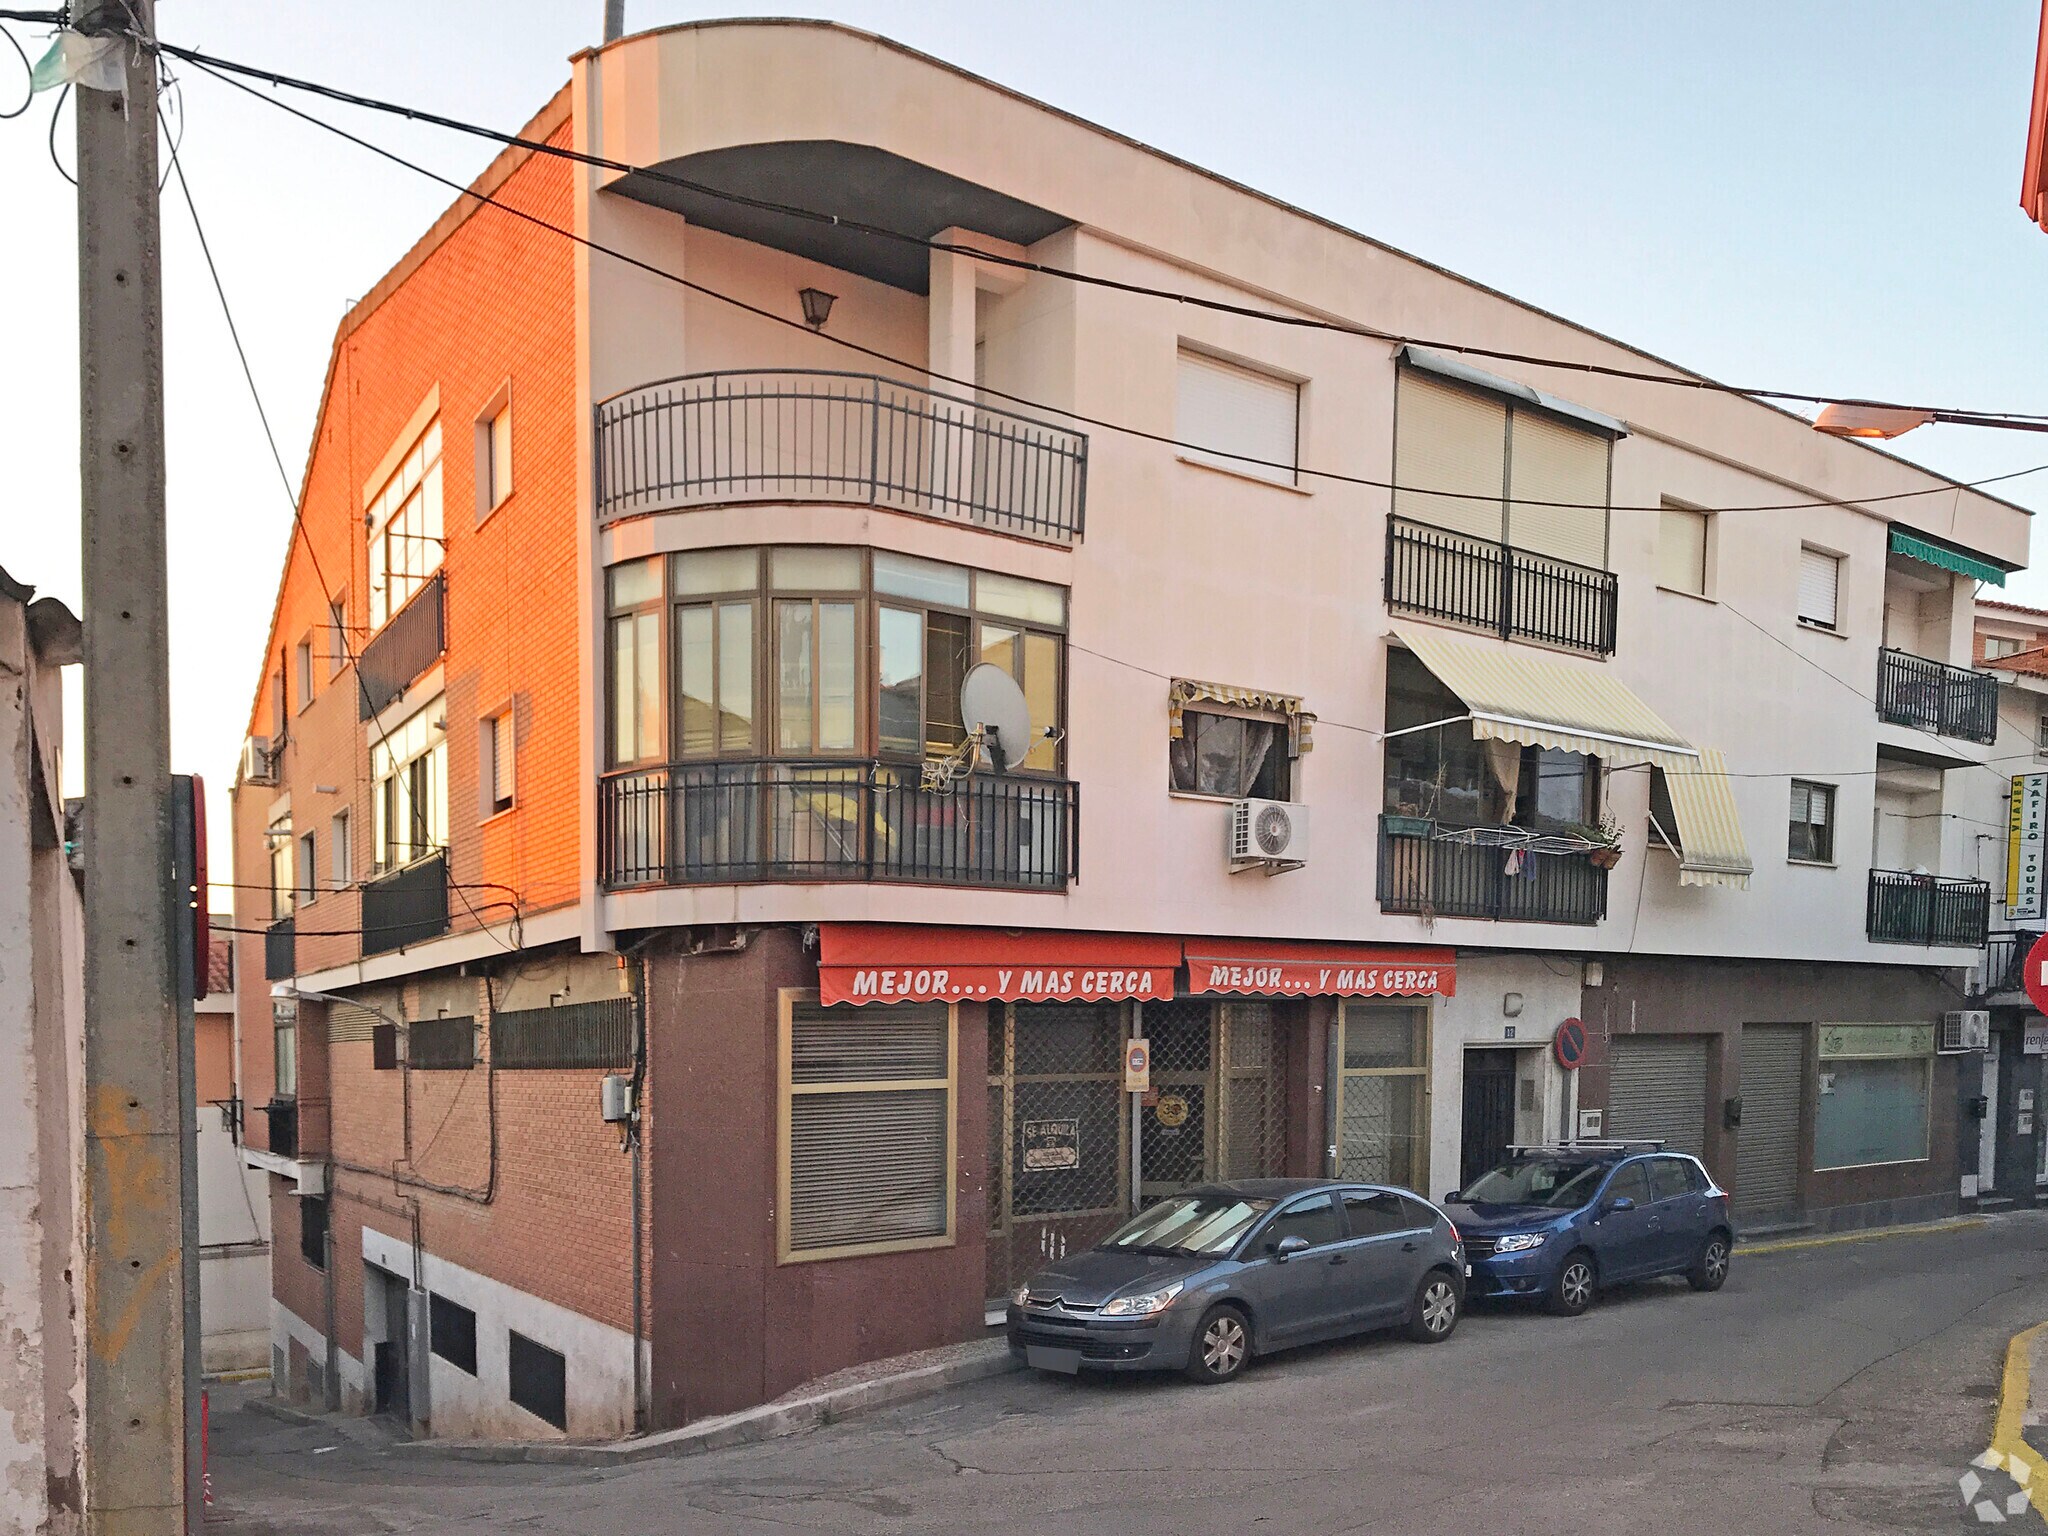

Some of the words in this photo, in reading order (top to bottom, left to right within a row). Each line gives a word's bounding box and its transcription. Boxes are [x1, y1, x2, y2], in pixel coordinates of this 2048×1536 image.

[2011, 781, 2022, 832] VIAJES
[2027, 779, 2042, 840] ZAFIRO
[2025, 854, 2037, 905] TOURS
[852, 970, 987, 995] MEJOR...
[998, 970, 1013, 994] Y
[1019, 970, 1074, 994] MAS
[1080, 970, 1153, 994] CERCA
[1209, 965, 1311, 989] MEJOR...
[1318, 969, 1331, 990] Y
[1336, 969, 1377, 990] MAS
[1383, 970, 1439, 989] CERCA
